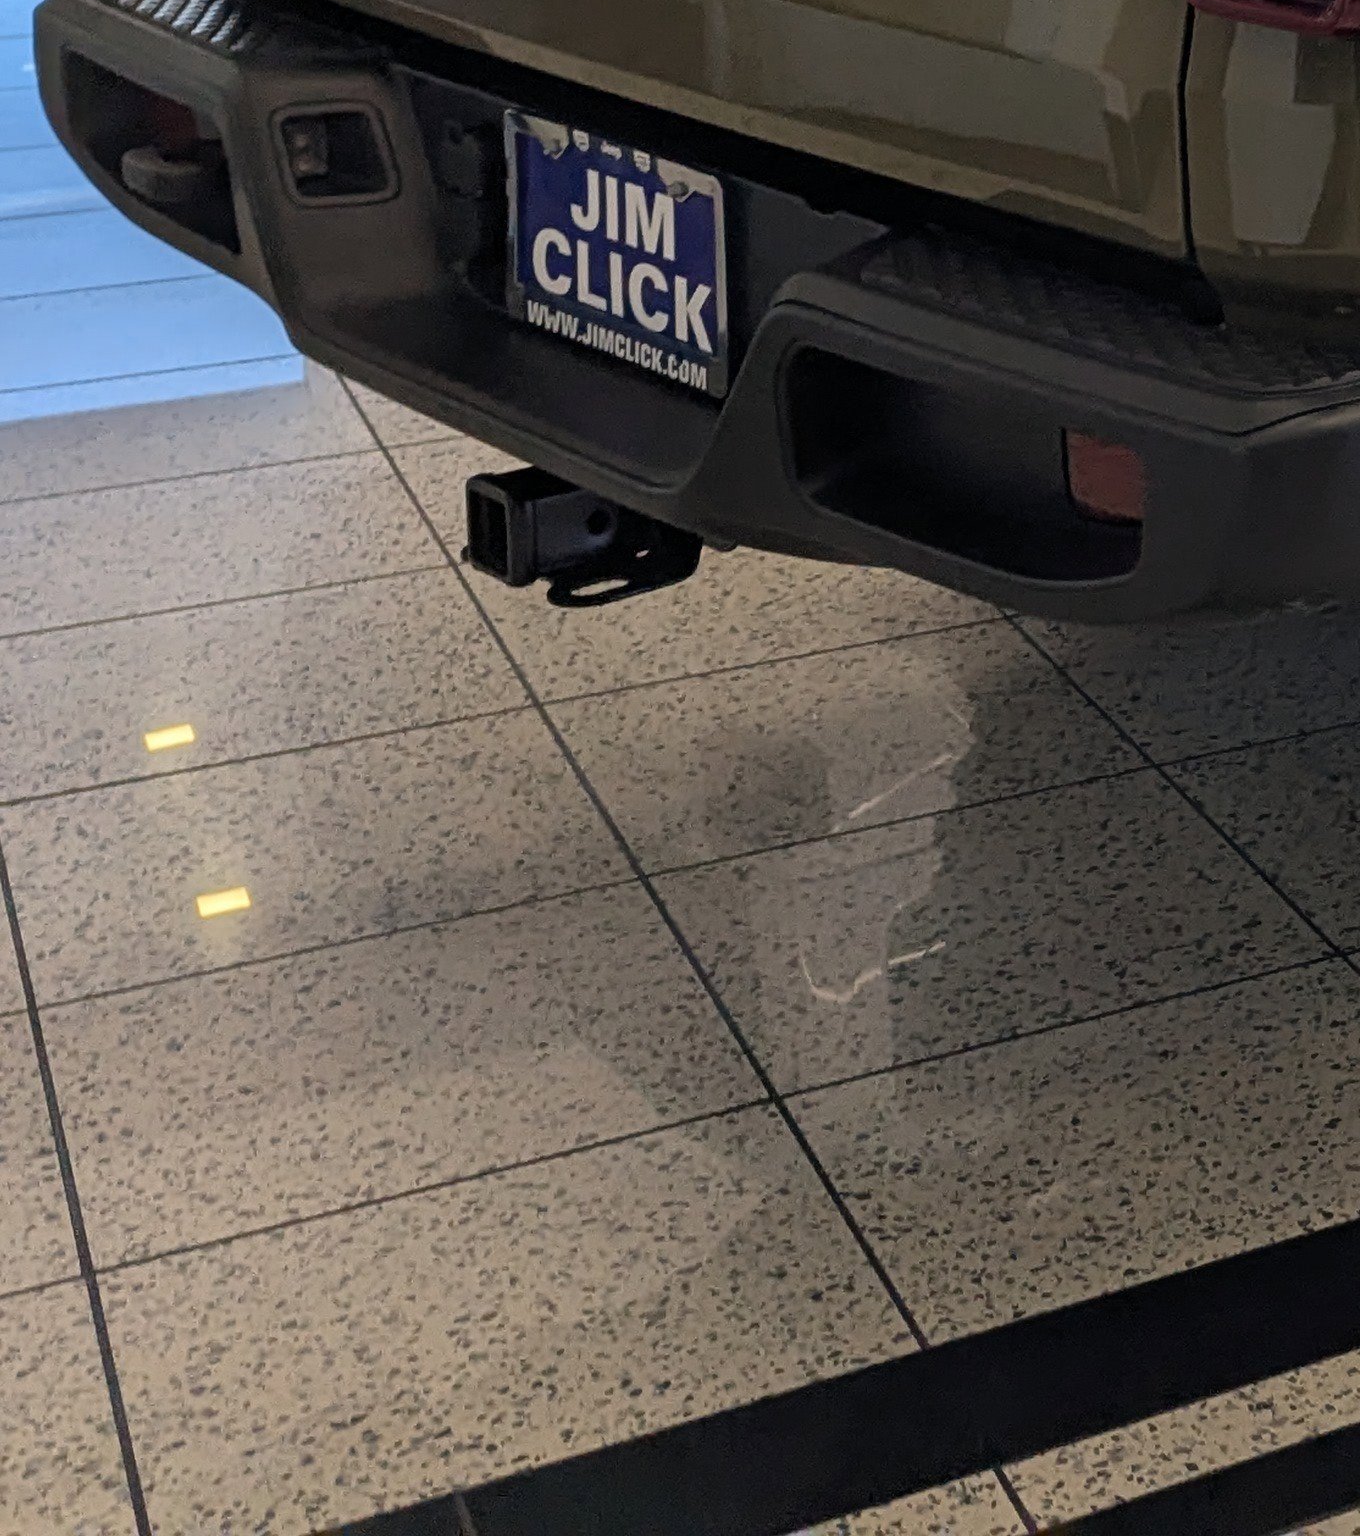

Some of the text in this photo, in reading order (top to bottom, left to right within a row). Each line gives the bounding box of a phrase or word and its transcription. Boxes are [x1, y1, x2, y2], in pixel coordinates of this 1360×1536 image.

[571, 169, 675, 261] JIM
[532, 228, 713, 353] CLICK
[526, 299, 708, 391] WWW.JIMCLICK.COM
